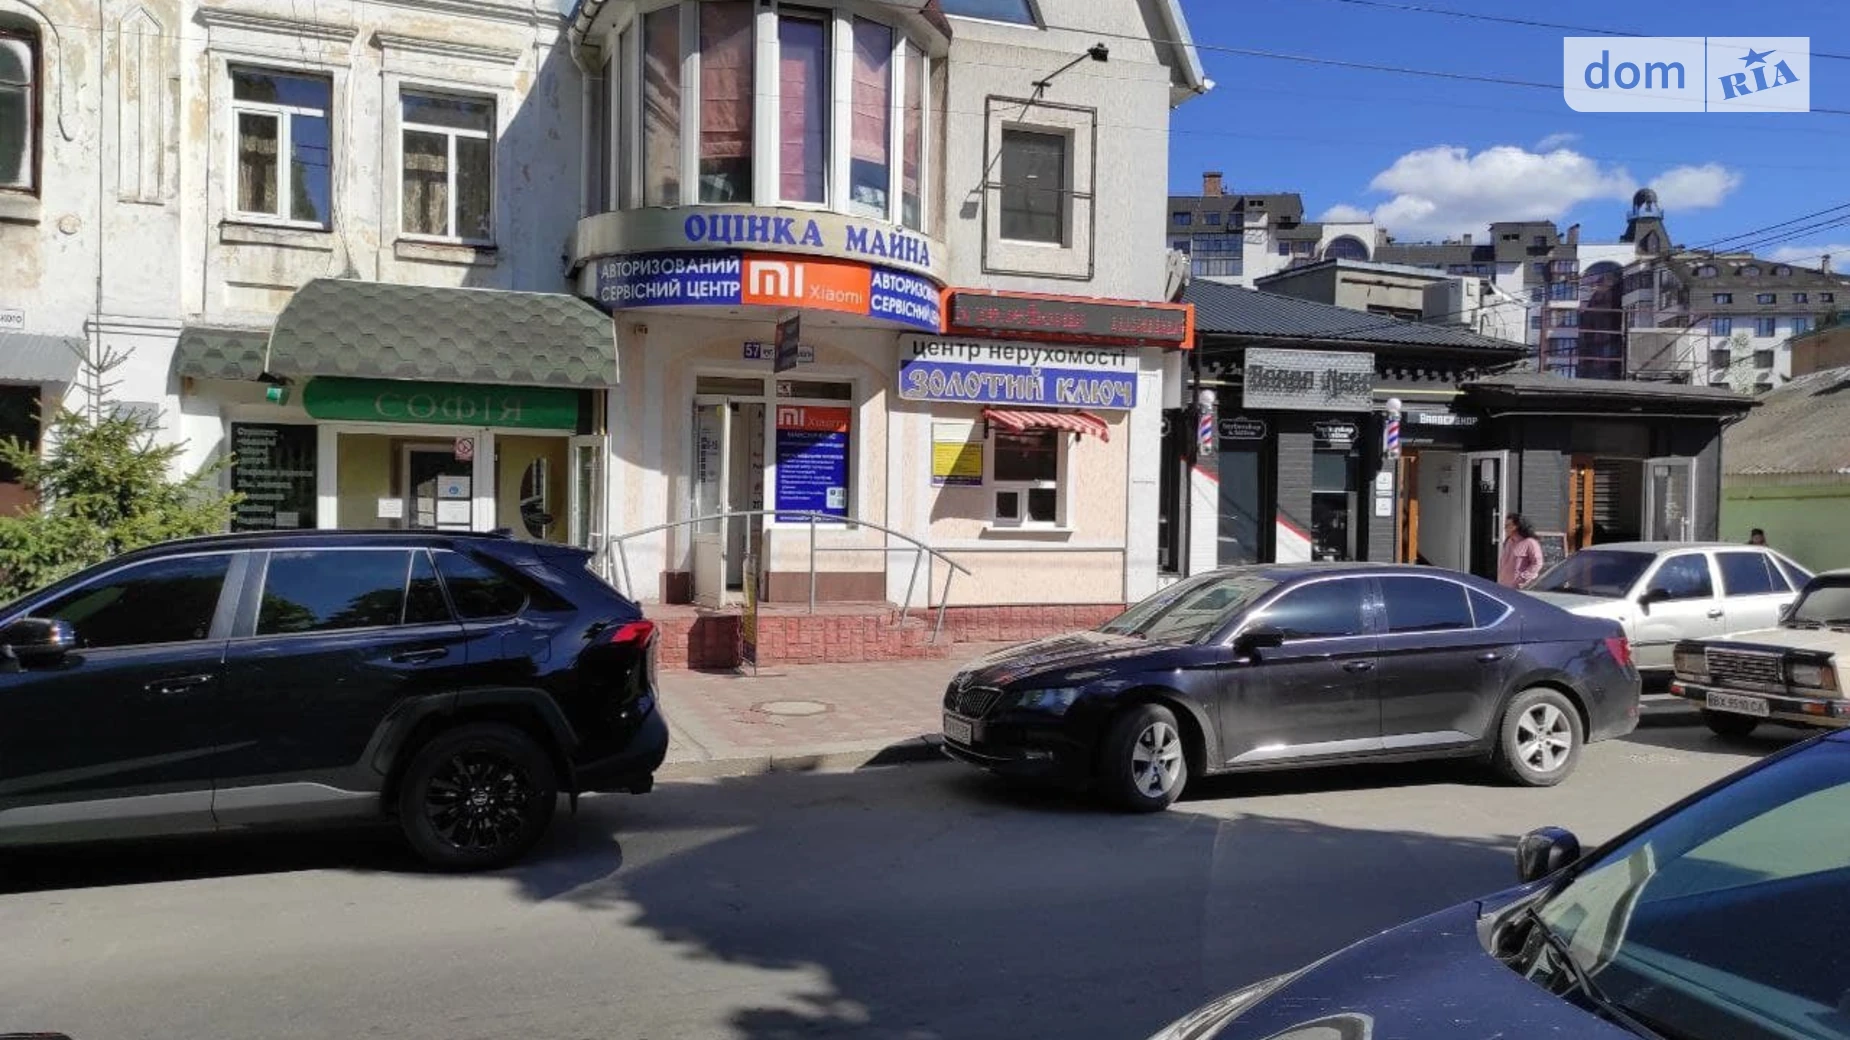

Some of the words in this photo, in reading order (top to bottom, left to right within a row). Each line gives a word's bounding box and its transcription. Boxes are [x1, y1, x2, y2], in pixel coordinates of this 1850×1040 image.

[684, 214, 824, 248] ОЦІНКА
[845, 224, 931, 267] МАЙНА
[601, 256, 740, 280] АВТОРИЗОВАНИЙ
[601, 279, 681, 302] СЕРВІСНИЙ
[687, 280, 741, 300] ЦЕНТР
[809, 283, 863, 304] Xiaomi
[745, 343, 760, 358] 57
[912, 340, 980, 361] центр
[988, 346, 1126, 366] нерухомості
[907, 367, 1044, 402] ЗОЛОТИЙ
[1056, 376, 1133, 407] КЛЮЧ
[375, 392, 522, 421] СОФІЯ
